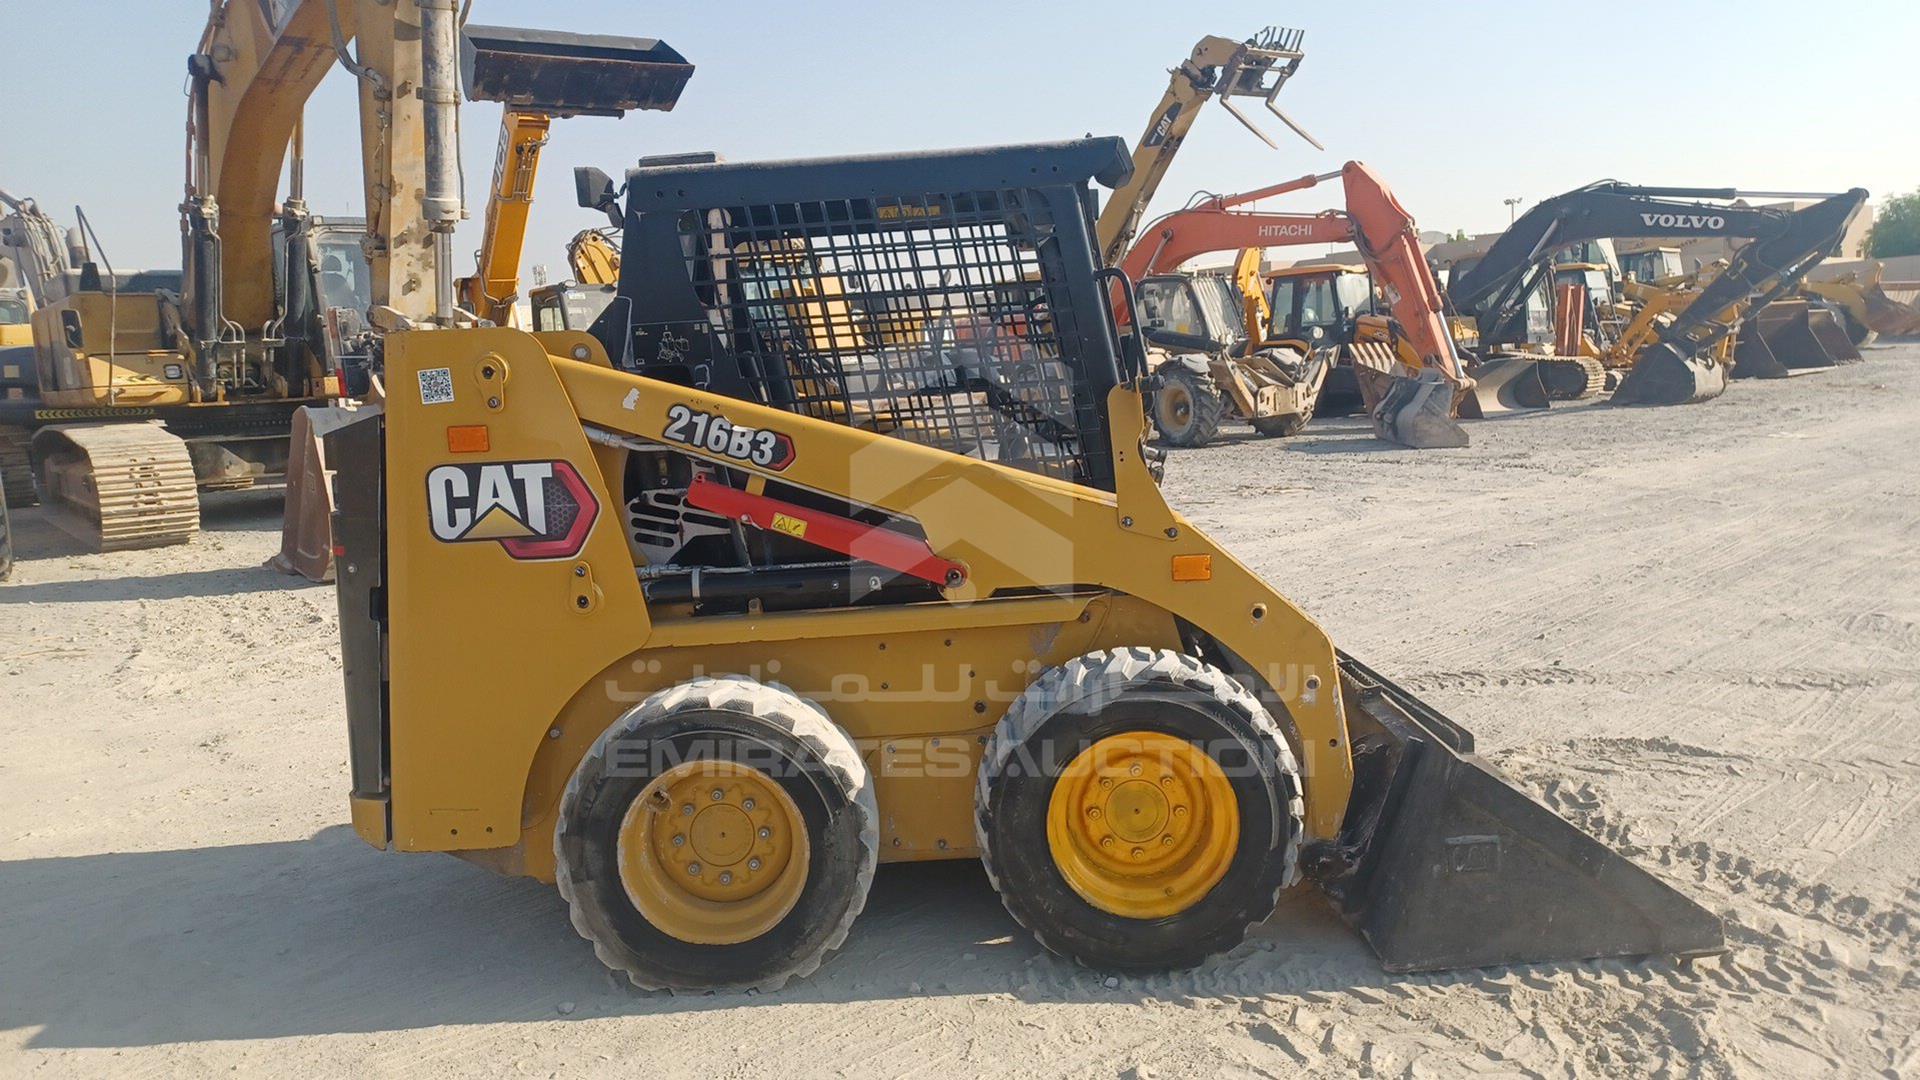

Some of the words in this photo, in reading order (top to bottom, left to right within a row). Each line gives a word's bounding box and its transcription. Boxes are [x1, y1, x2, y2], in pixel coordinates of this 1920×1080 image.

[1157, 113, 1172, 137] CAT
[495, 123, 509, 190] JCB
[1258, 224, 1313, 236] HITACHI
[1640, 213, 1725, 230] VOLVO
[664, 405, 776, 465] 216B3
[428, 462, 552, 540] CAT
